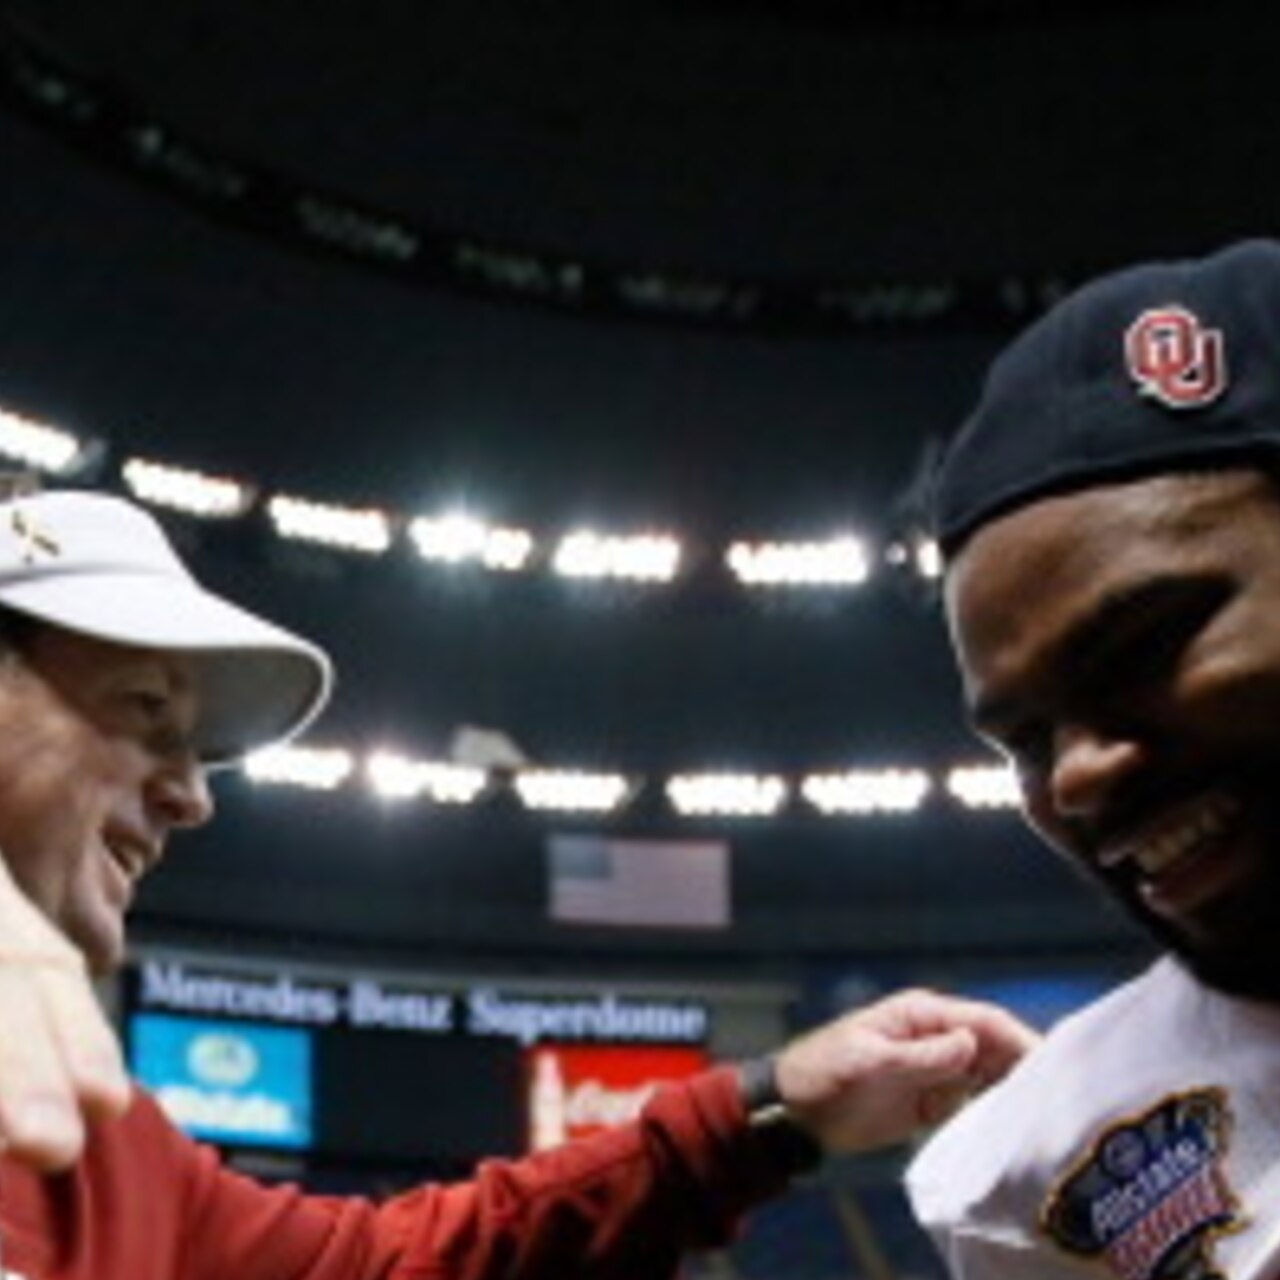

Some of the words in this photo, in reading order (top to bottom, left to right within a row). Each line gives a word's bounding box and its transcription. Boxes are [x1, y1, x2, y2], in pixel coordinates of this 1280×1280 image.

[1124, 304, 1227, 408] OU
[141, 959, 452, 1029] Mercedes-Benz
[469, 987, 706, 1046] Superdome
